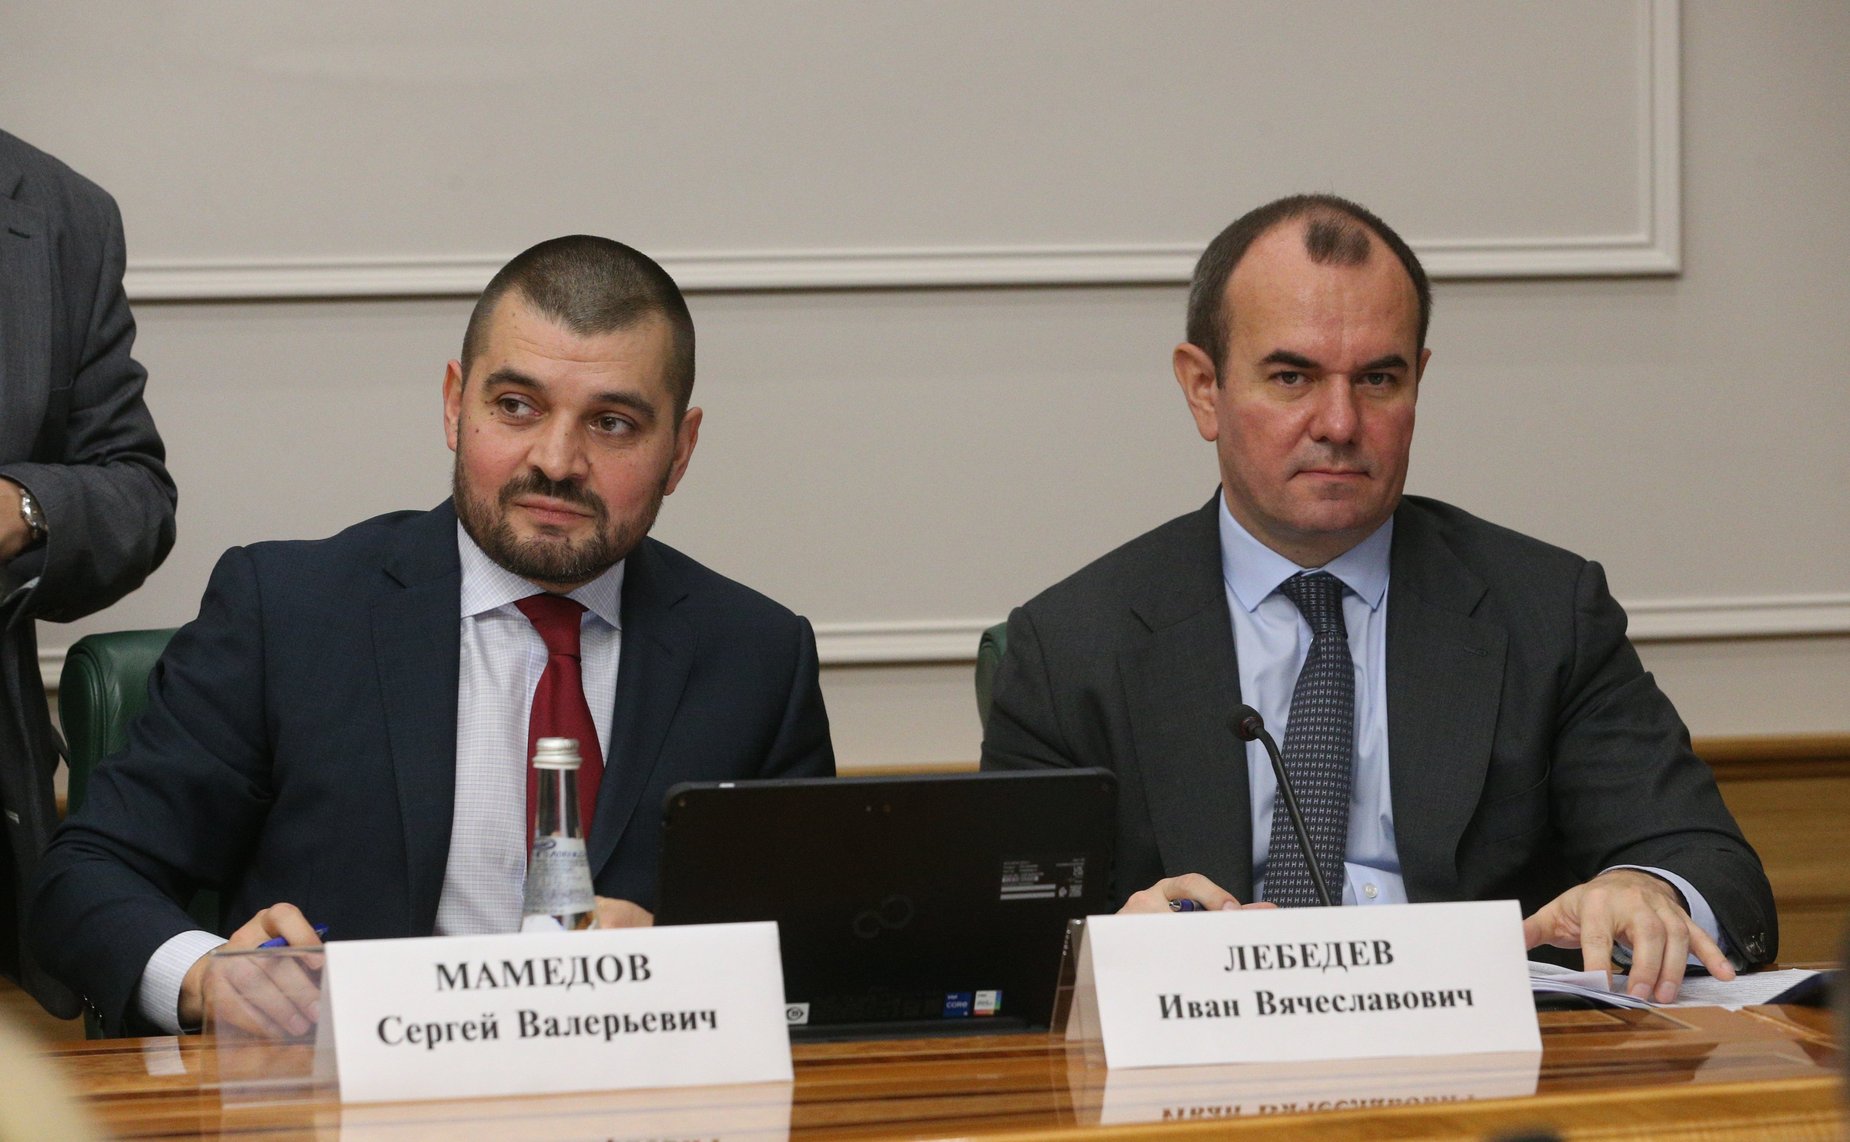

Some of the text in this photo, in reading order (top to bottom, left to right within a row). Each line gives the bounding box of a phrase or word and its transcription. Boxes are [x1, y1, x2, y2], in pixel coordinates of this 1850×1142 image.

[436, 953, 652, 991] МАМЕДОВ
[1223, 940, 1395, 973] ЛЕБЕДЕВ
[1158, 986, 1474, 1020] Иван Вячеславович
[376, 1006, 718, 1050] Сергей Валерьевич
